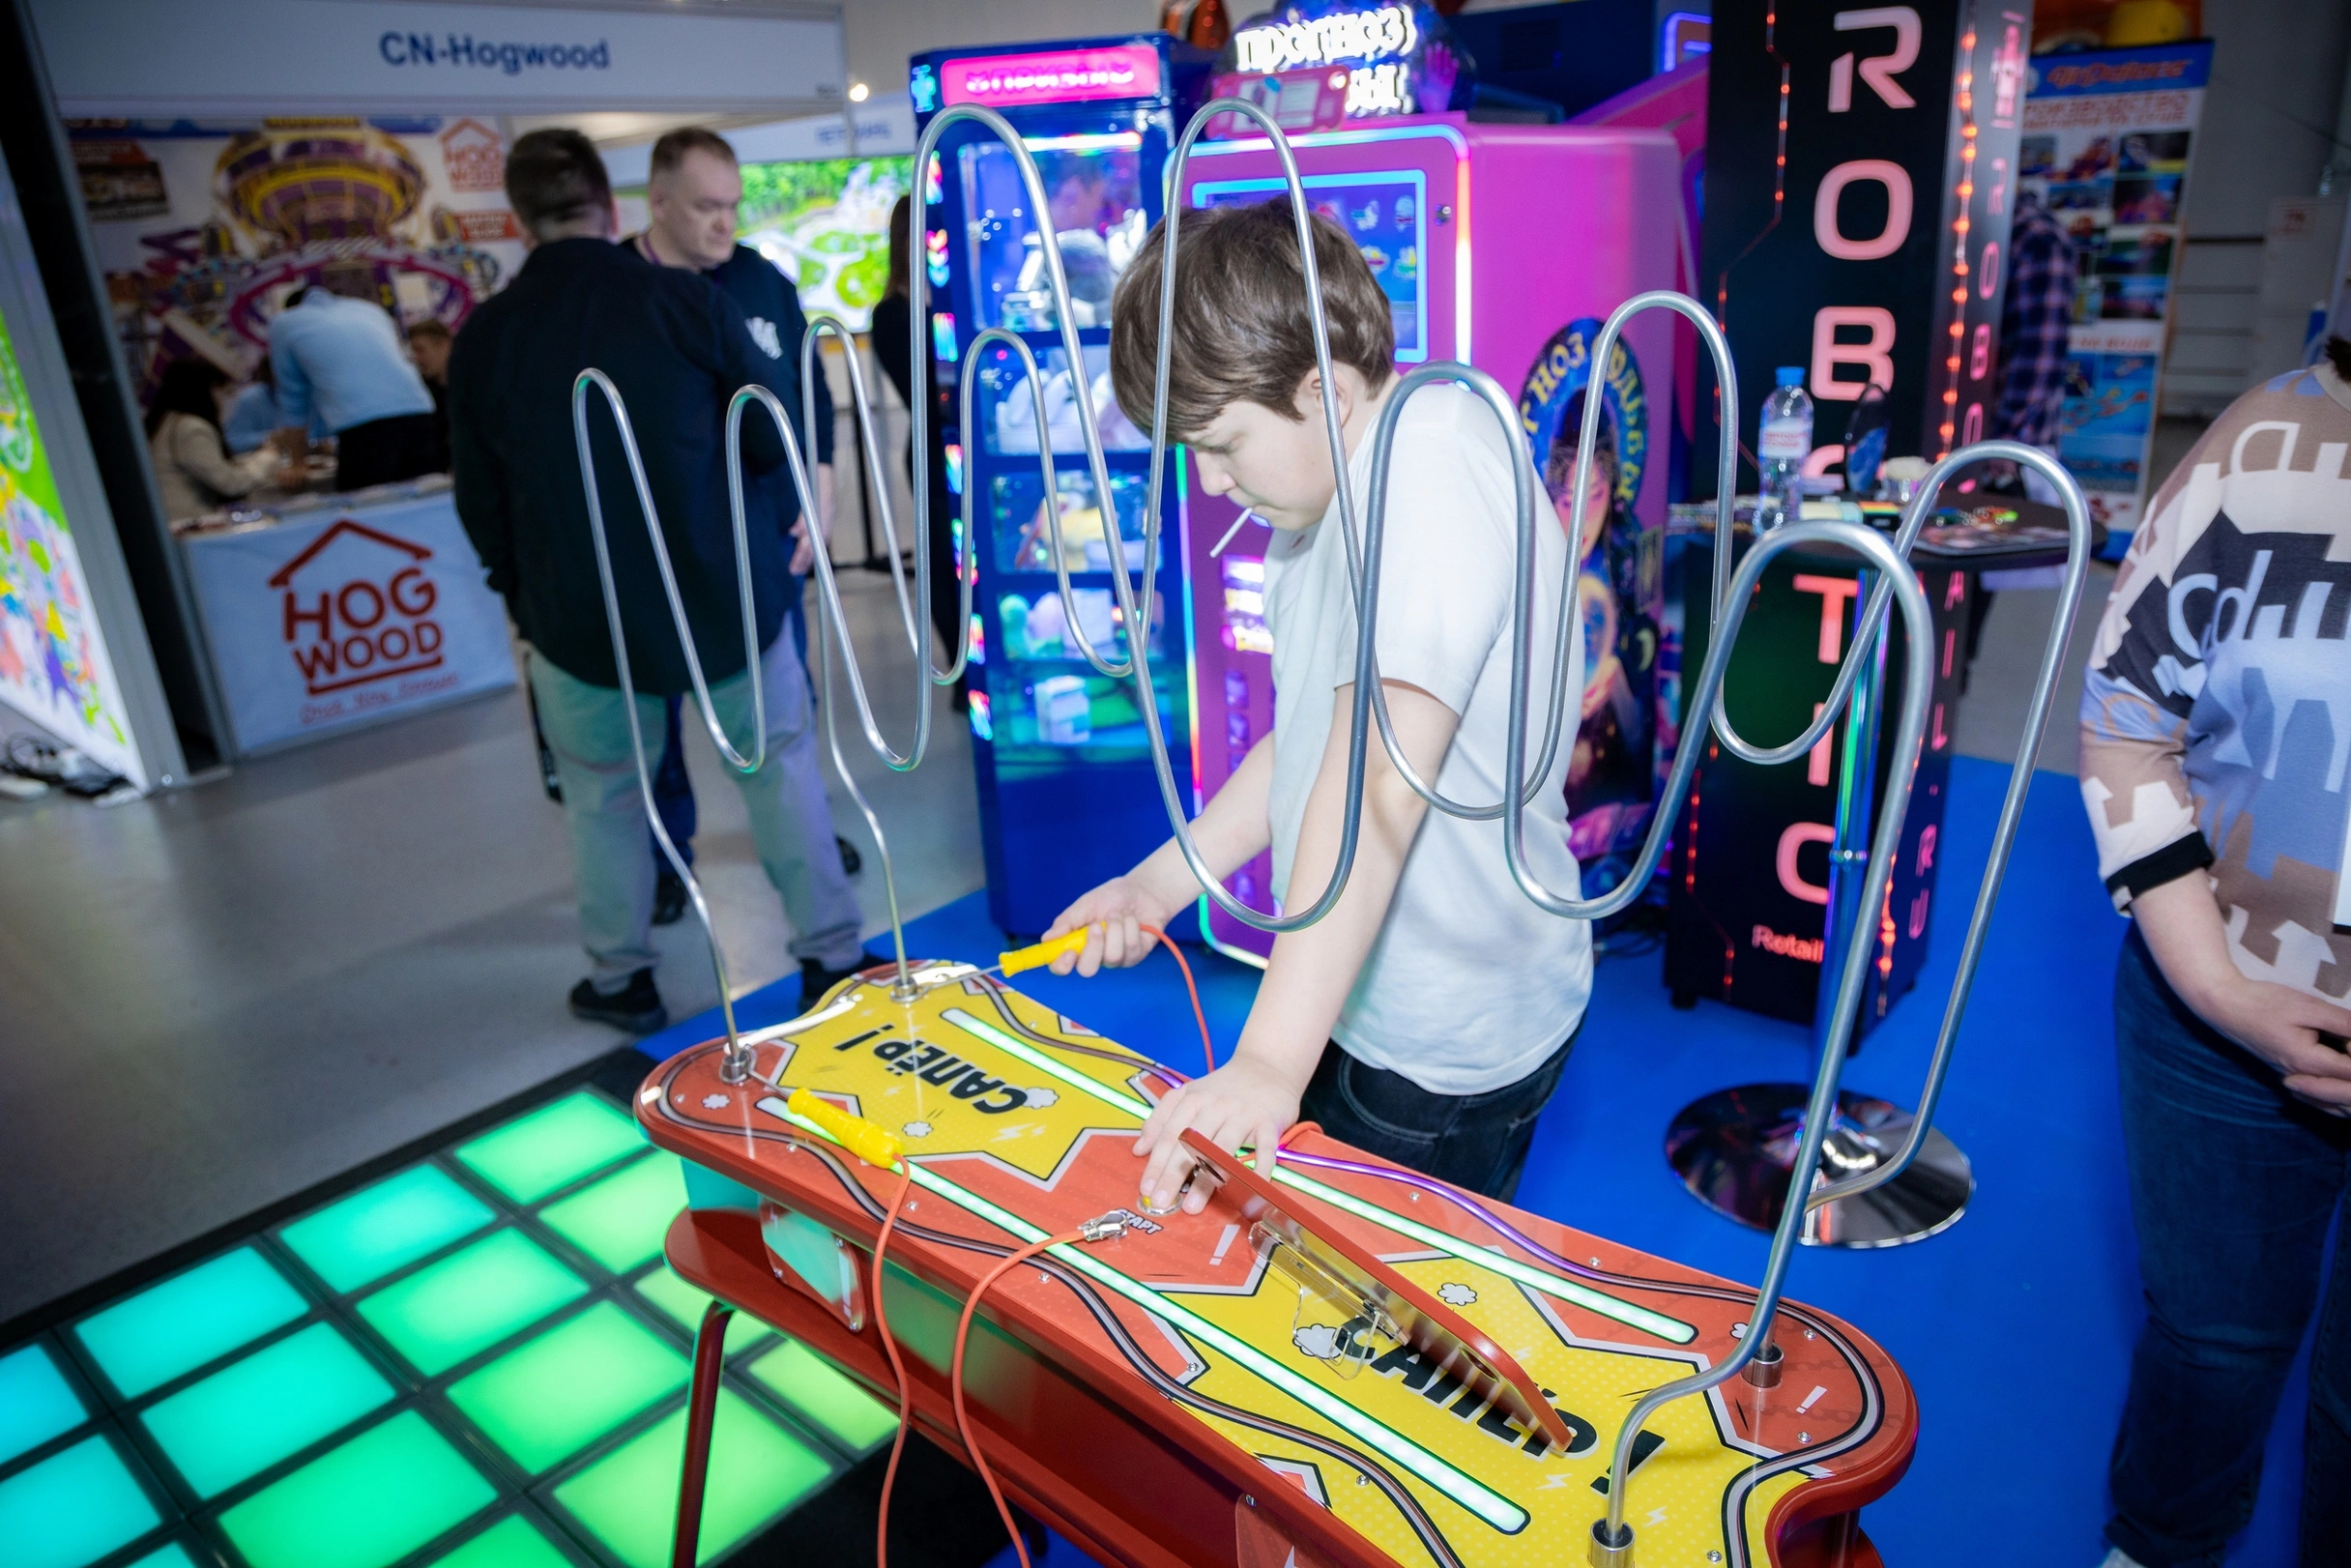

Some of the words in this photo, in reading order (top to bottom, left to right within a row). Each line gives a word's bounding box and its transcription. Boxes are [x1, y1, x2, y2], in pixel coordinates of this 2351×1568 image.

[379, 32, 610, 75] CN-Hogwood
[283, 567, 437, 642] HOG
[293, 621, 443, 680] WOOD
[1752, 924, 1824, 964] Retail
